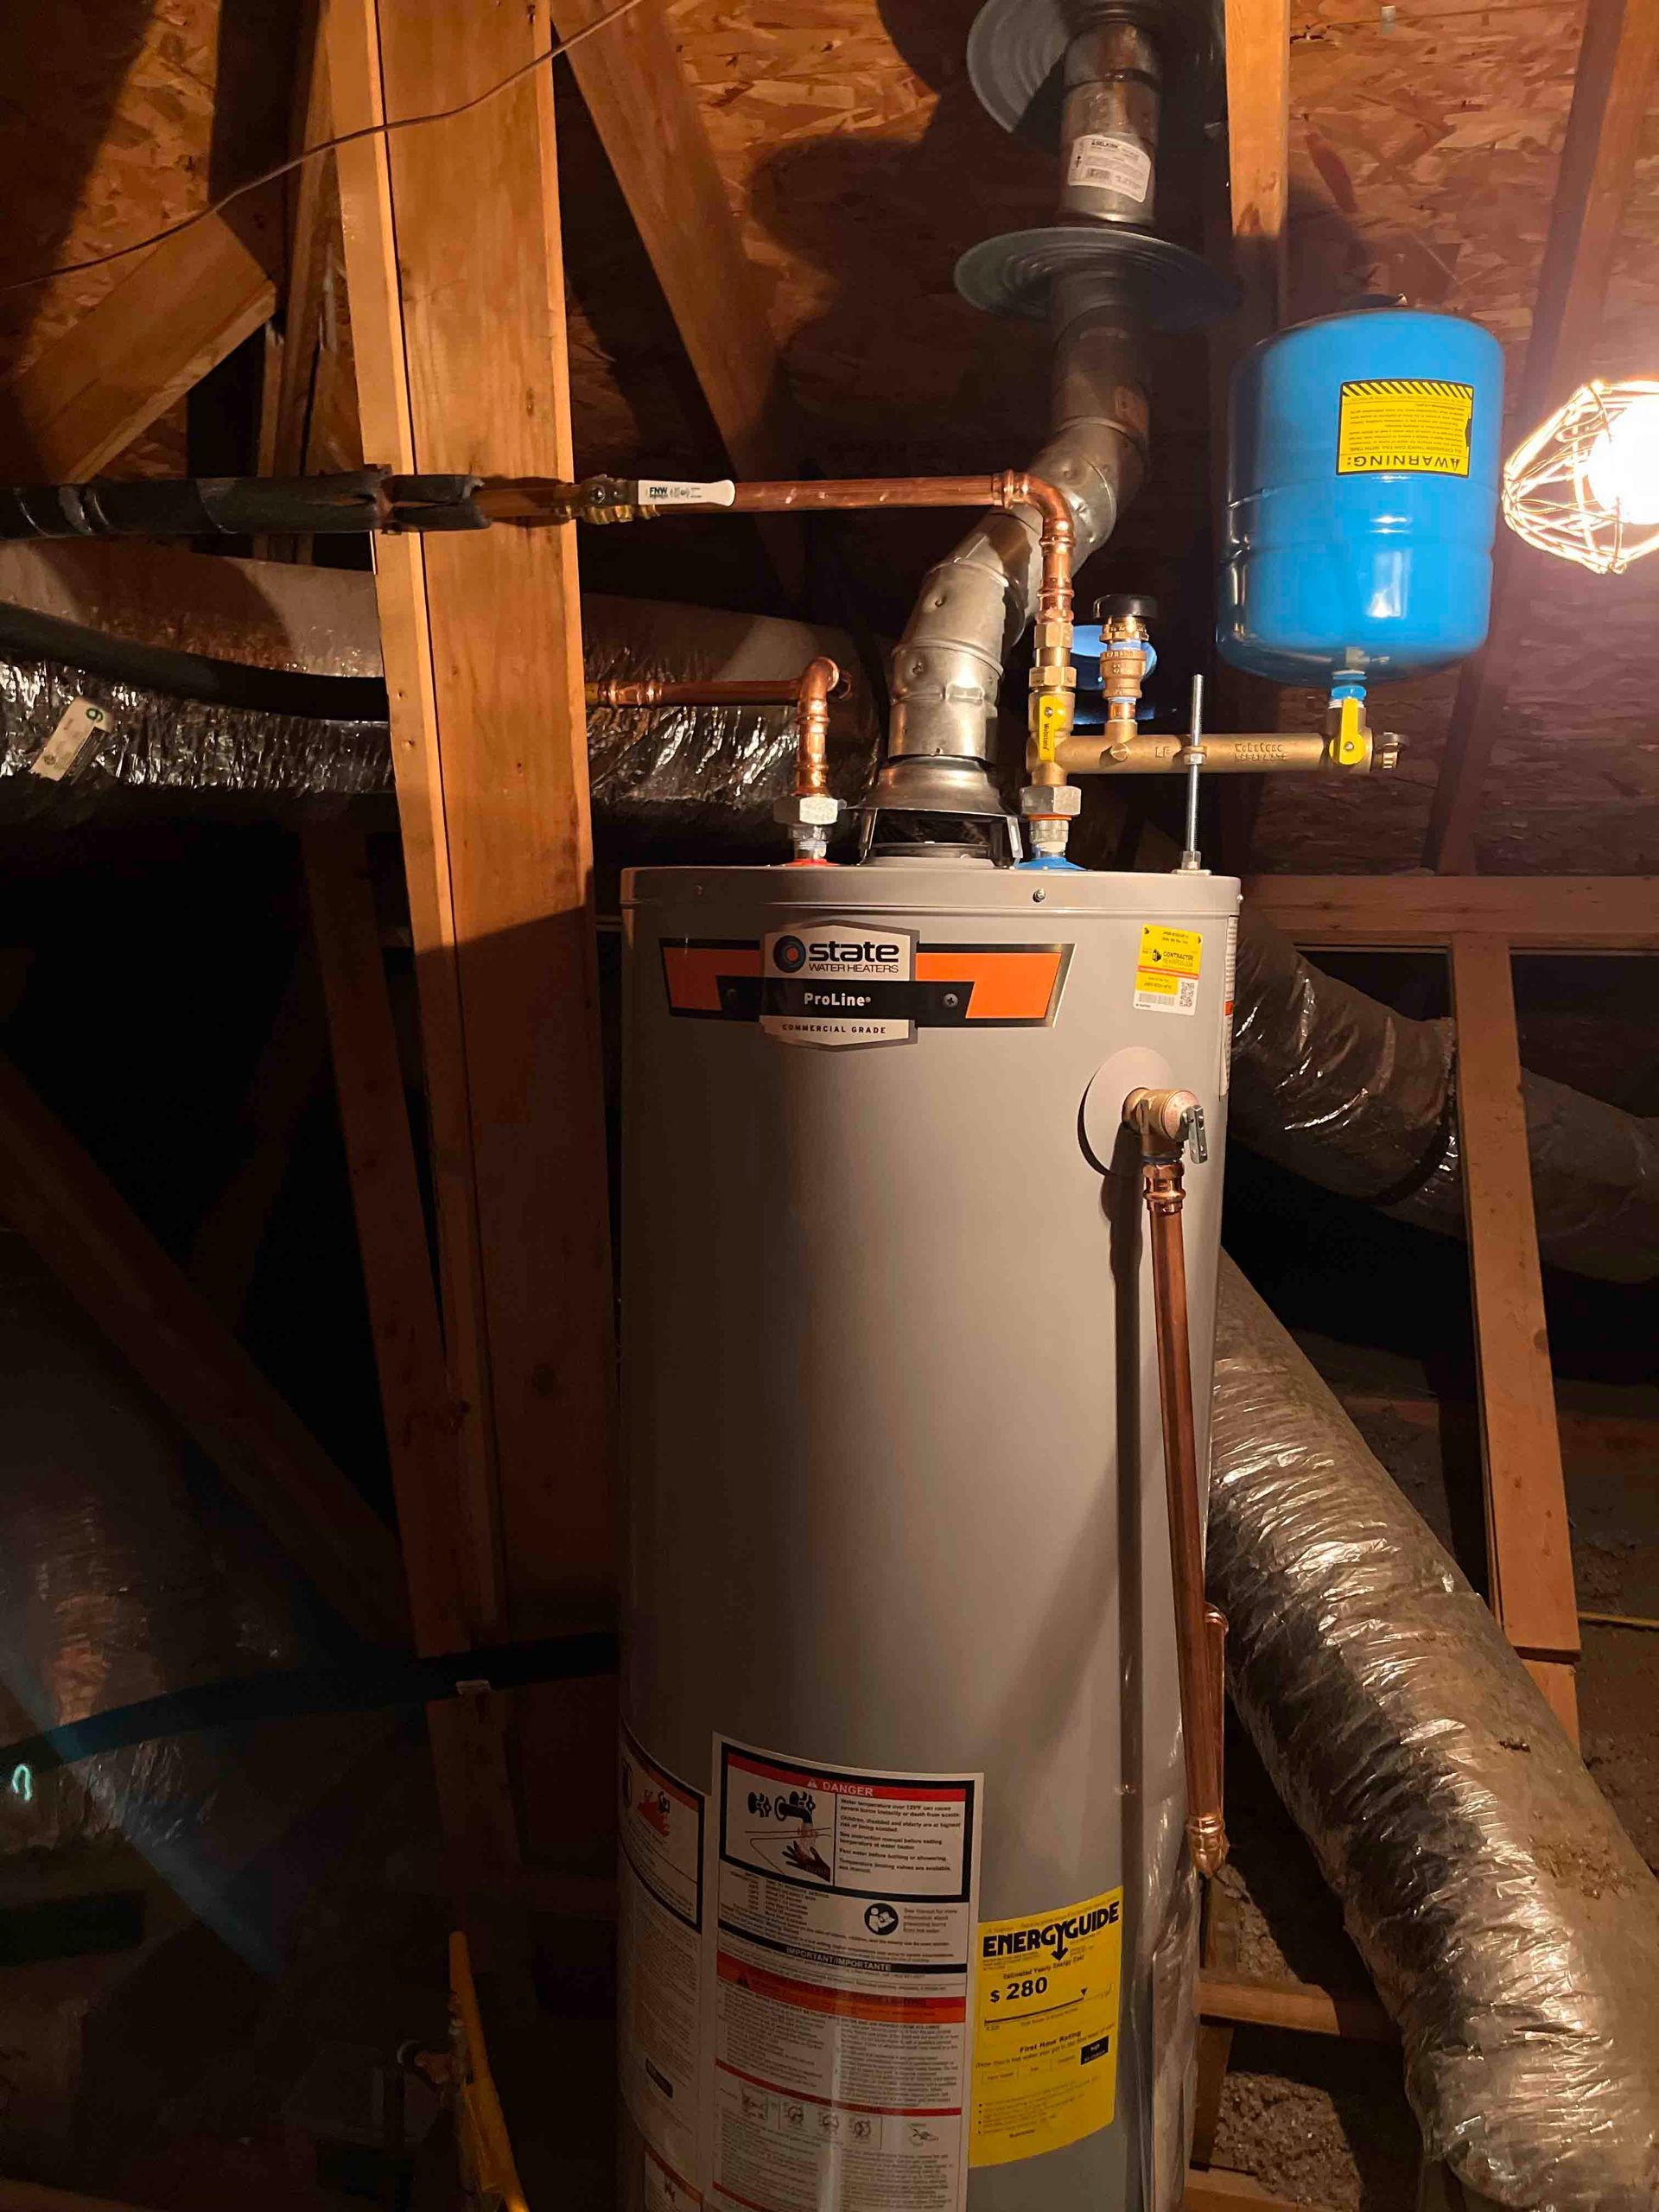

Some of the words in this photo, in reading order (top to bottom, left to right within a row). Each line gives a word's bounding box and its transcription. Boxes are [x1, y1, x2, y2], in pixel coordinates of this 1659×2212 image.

[1347, 454, 1448, 468] WARNING:
[809, 941, 899, 963] state
[1163, 950, 1194, 961] CONTRACTOR
[809, 963, 846, 972] WATER
[848, 964, 899, 973] HEATERS
[782, 1024, 846, 1033] COMMERCIAL
[823, 1781, 874, 1796] DANGER
[982, 1901, 1120, 1961] ENERGYGUIDE
[785, 1946, 892, 1972] IMPORTANT/IMPORTANTE
[1034, 1965, 1052, 1974] Yearly
[1053, 1960, 1071, 1969] Energy
[1073, 1955, 1084, 1963] Cost
[1006, 1977, 1048, 2000] 280
[1020, 2044, 1037, 2053] First
[1039, 2039, 1057, 2048] Hour
[1059, 2031, 1082, 2043] Rating
